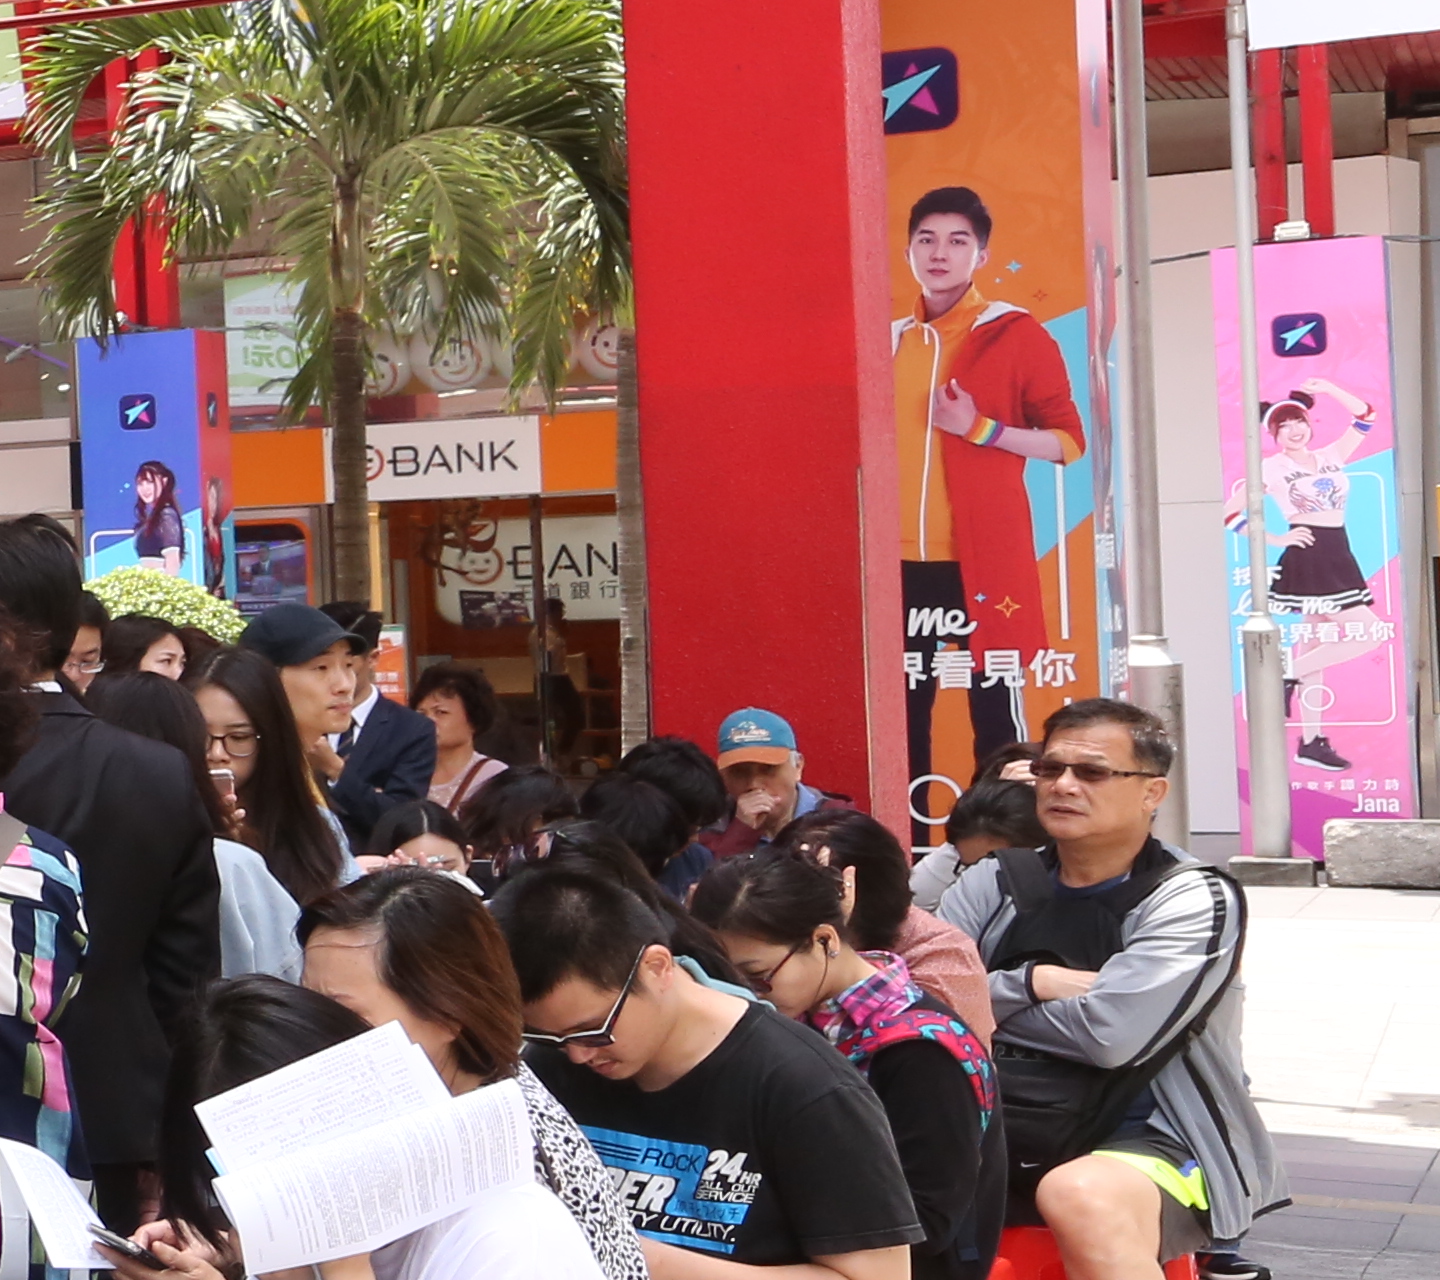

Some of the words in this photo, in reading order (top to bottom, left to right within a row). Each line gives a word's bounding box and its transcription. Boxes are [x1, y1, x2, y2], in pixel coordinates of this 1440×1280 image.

[906, 606, 978, 637] me
[1352, 792, 1401, 813] Jana
[640, 1148, 703, 1173] ROCK
[695, 1189, 756, 1204] SERVICE
[731, 1183, 758, 1193] OUT
